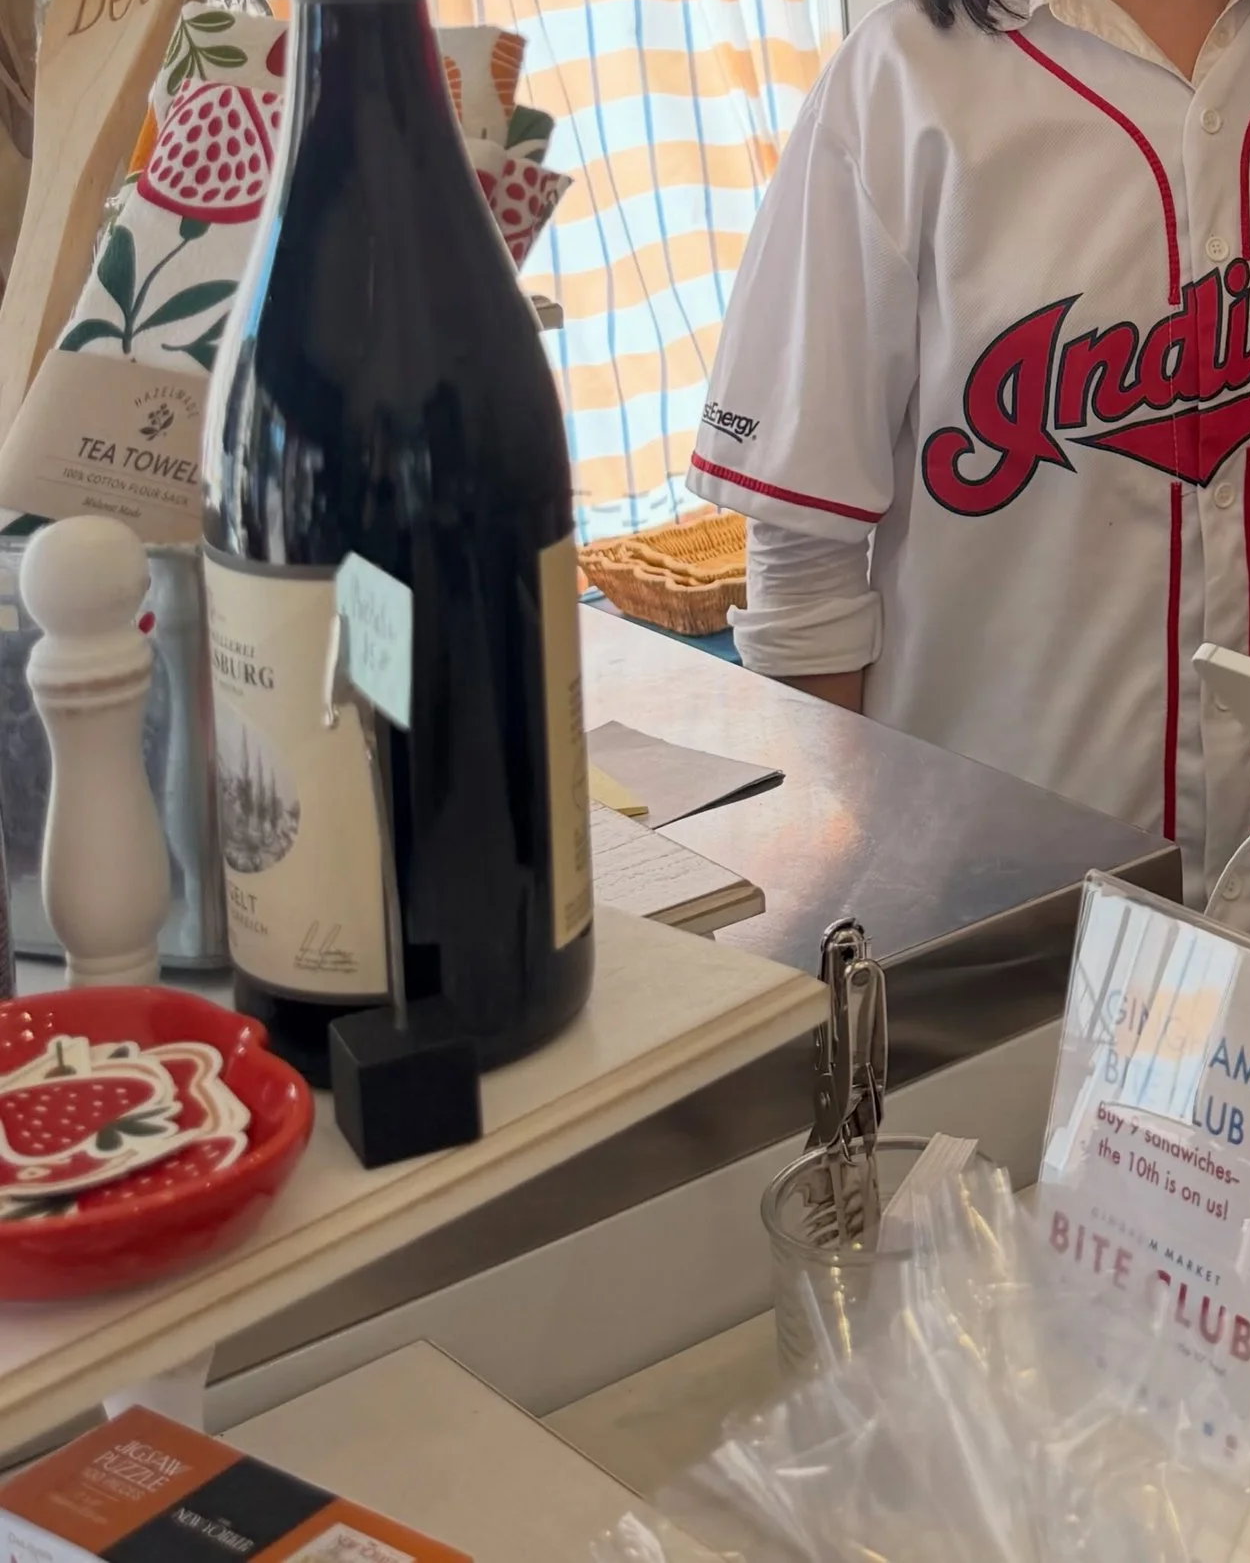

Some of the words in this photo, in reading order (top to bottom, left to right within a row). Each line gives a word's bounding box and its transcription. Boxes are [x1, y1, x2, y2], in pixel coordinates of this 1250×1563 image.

[78, 437, 117, 464] TEA
[87, 473, 126, 490] COTTON
[129, 482, 161, 499] FLOUR
[1186, 1094, 1245, 1146] LUB
[1098, 1137, 1121, 1165] the
[1129, 1151, 1160, 1186] 10th
[1165, 1170, 1177, 1194] is
[1181, 1186, 1201, 1207] on
[1206, 1198, 1229, 1221] us!
[1050, 1210, 1133, 1291] BITE
[1164, 1248, 1222, 1286] MARKET
[92, 1451, 171, 1494] PUZZLE
[114, 1440, 193, 1477] JIGSAW
[172, 1506, 202, 1529] NEW
